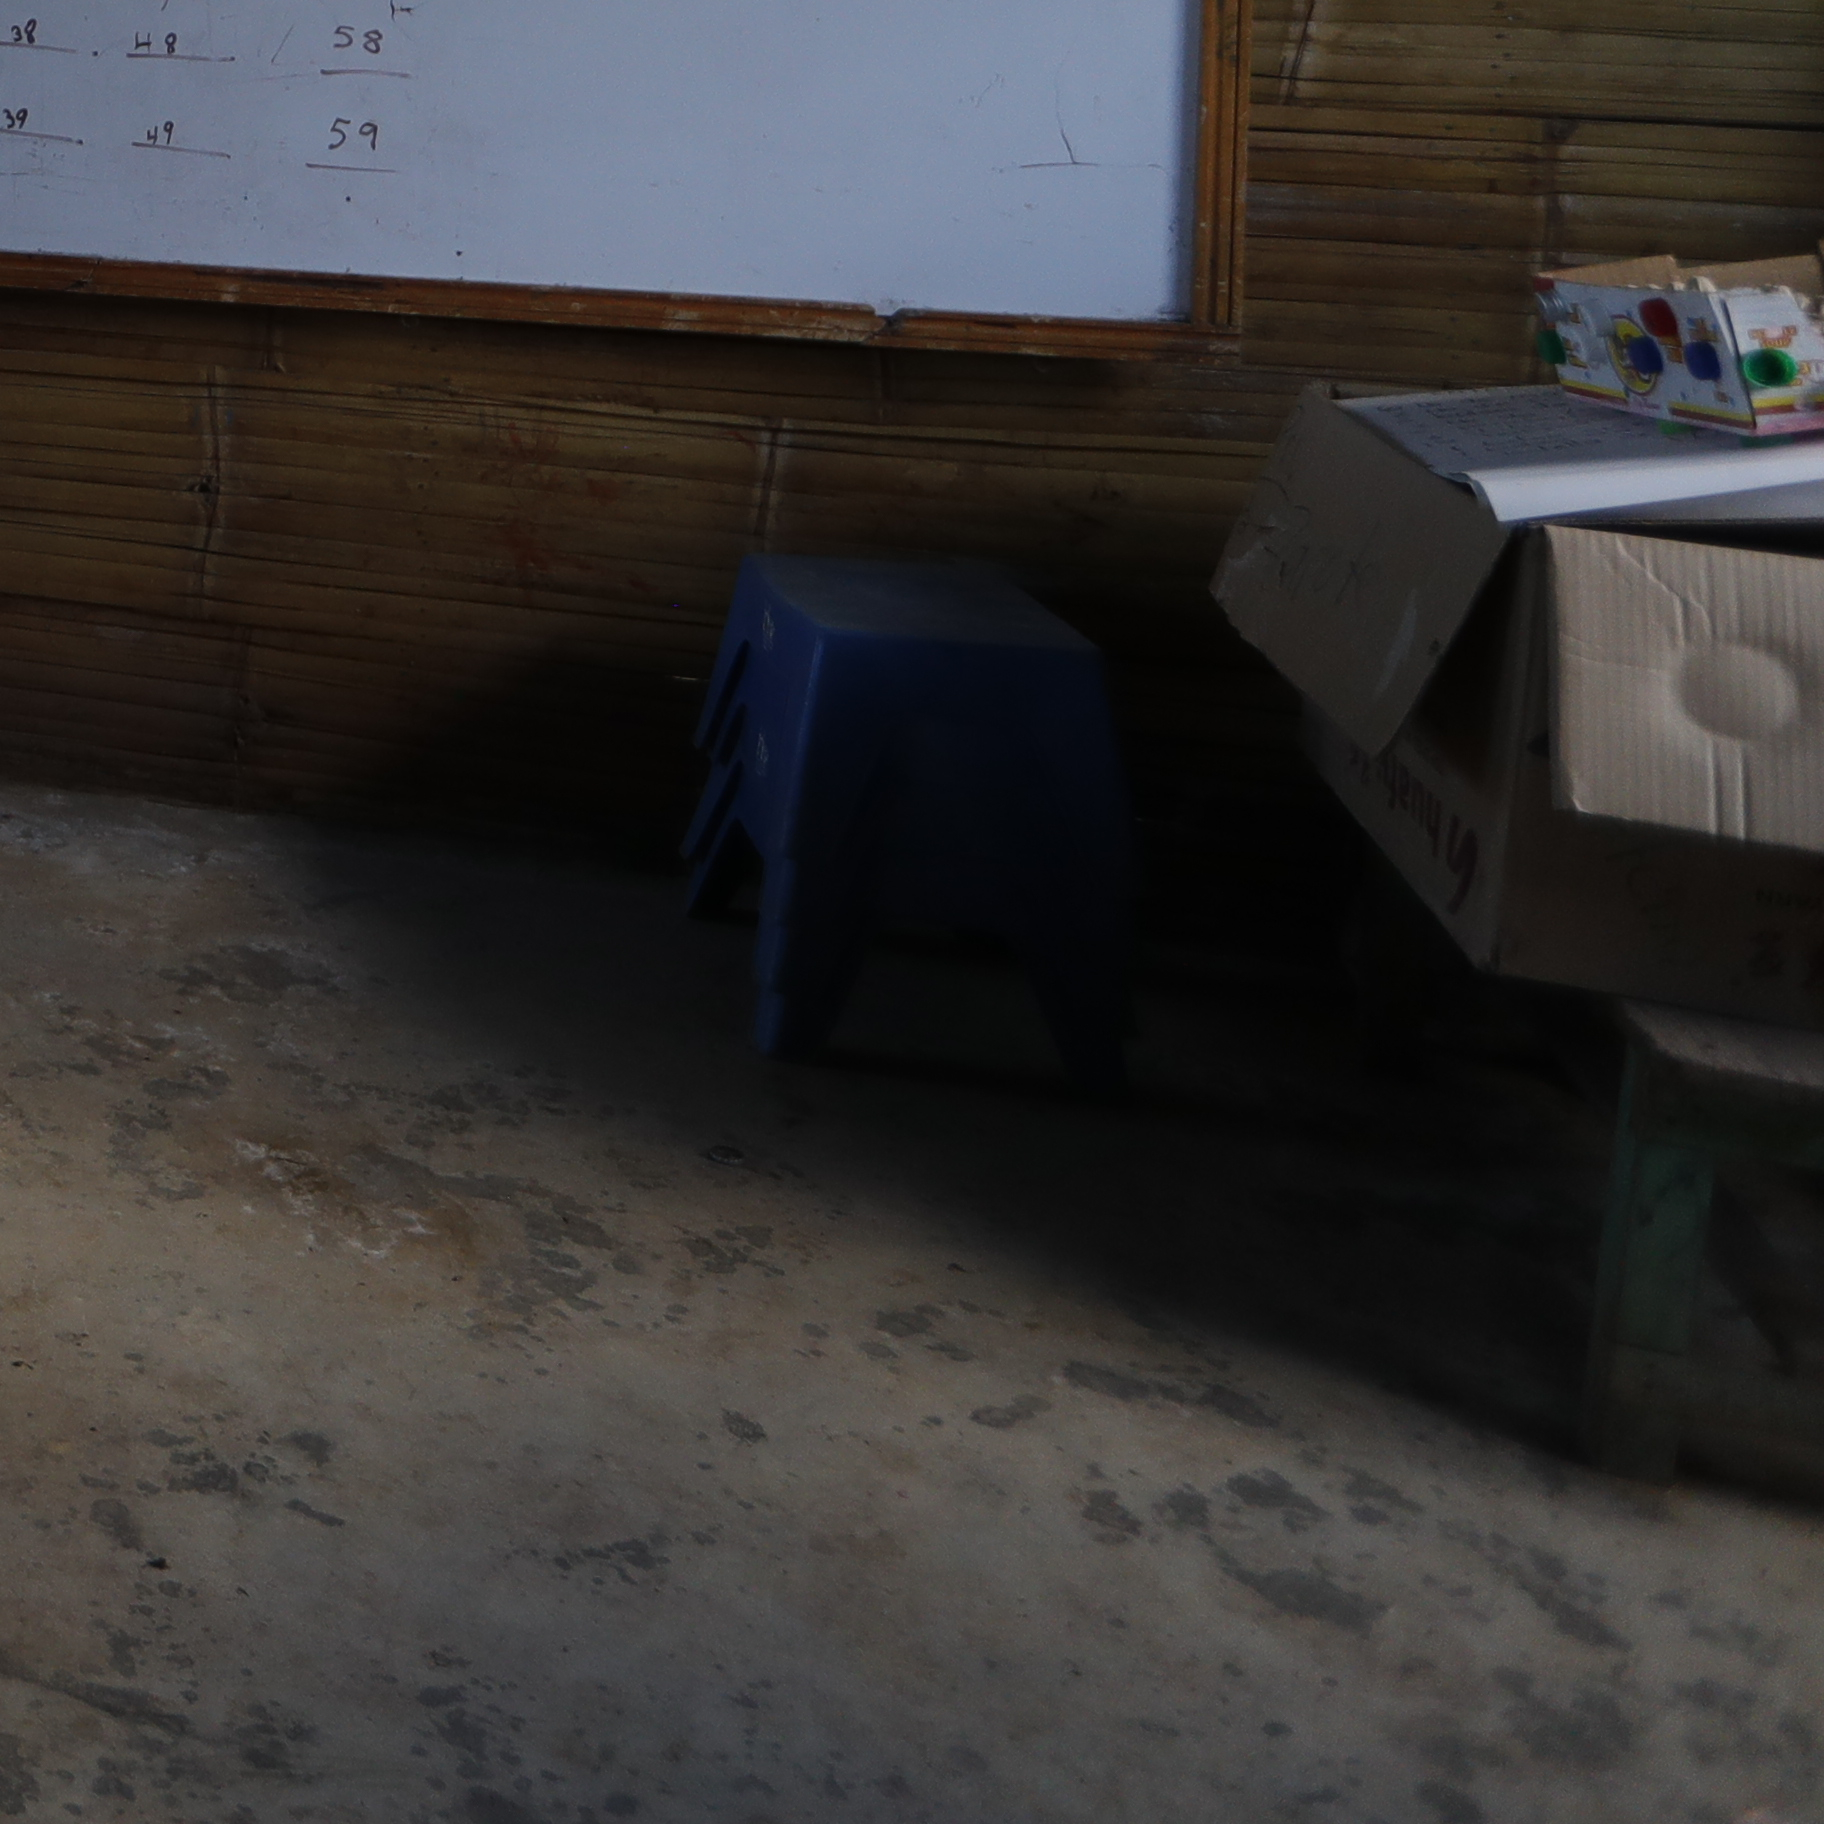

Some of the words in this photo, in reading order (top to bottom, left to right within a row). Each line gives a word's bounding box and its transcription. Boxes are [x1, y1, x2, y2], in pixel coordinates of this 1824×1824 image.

[11, 19, 37, 43] 38
[135, 32, 177, 54] 48
[333, 26, 383, 54] 58
[3, 108, 28, 129] 39
[147, 121, 174, 145] 49
[328, 117, 378, 151] 59
